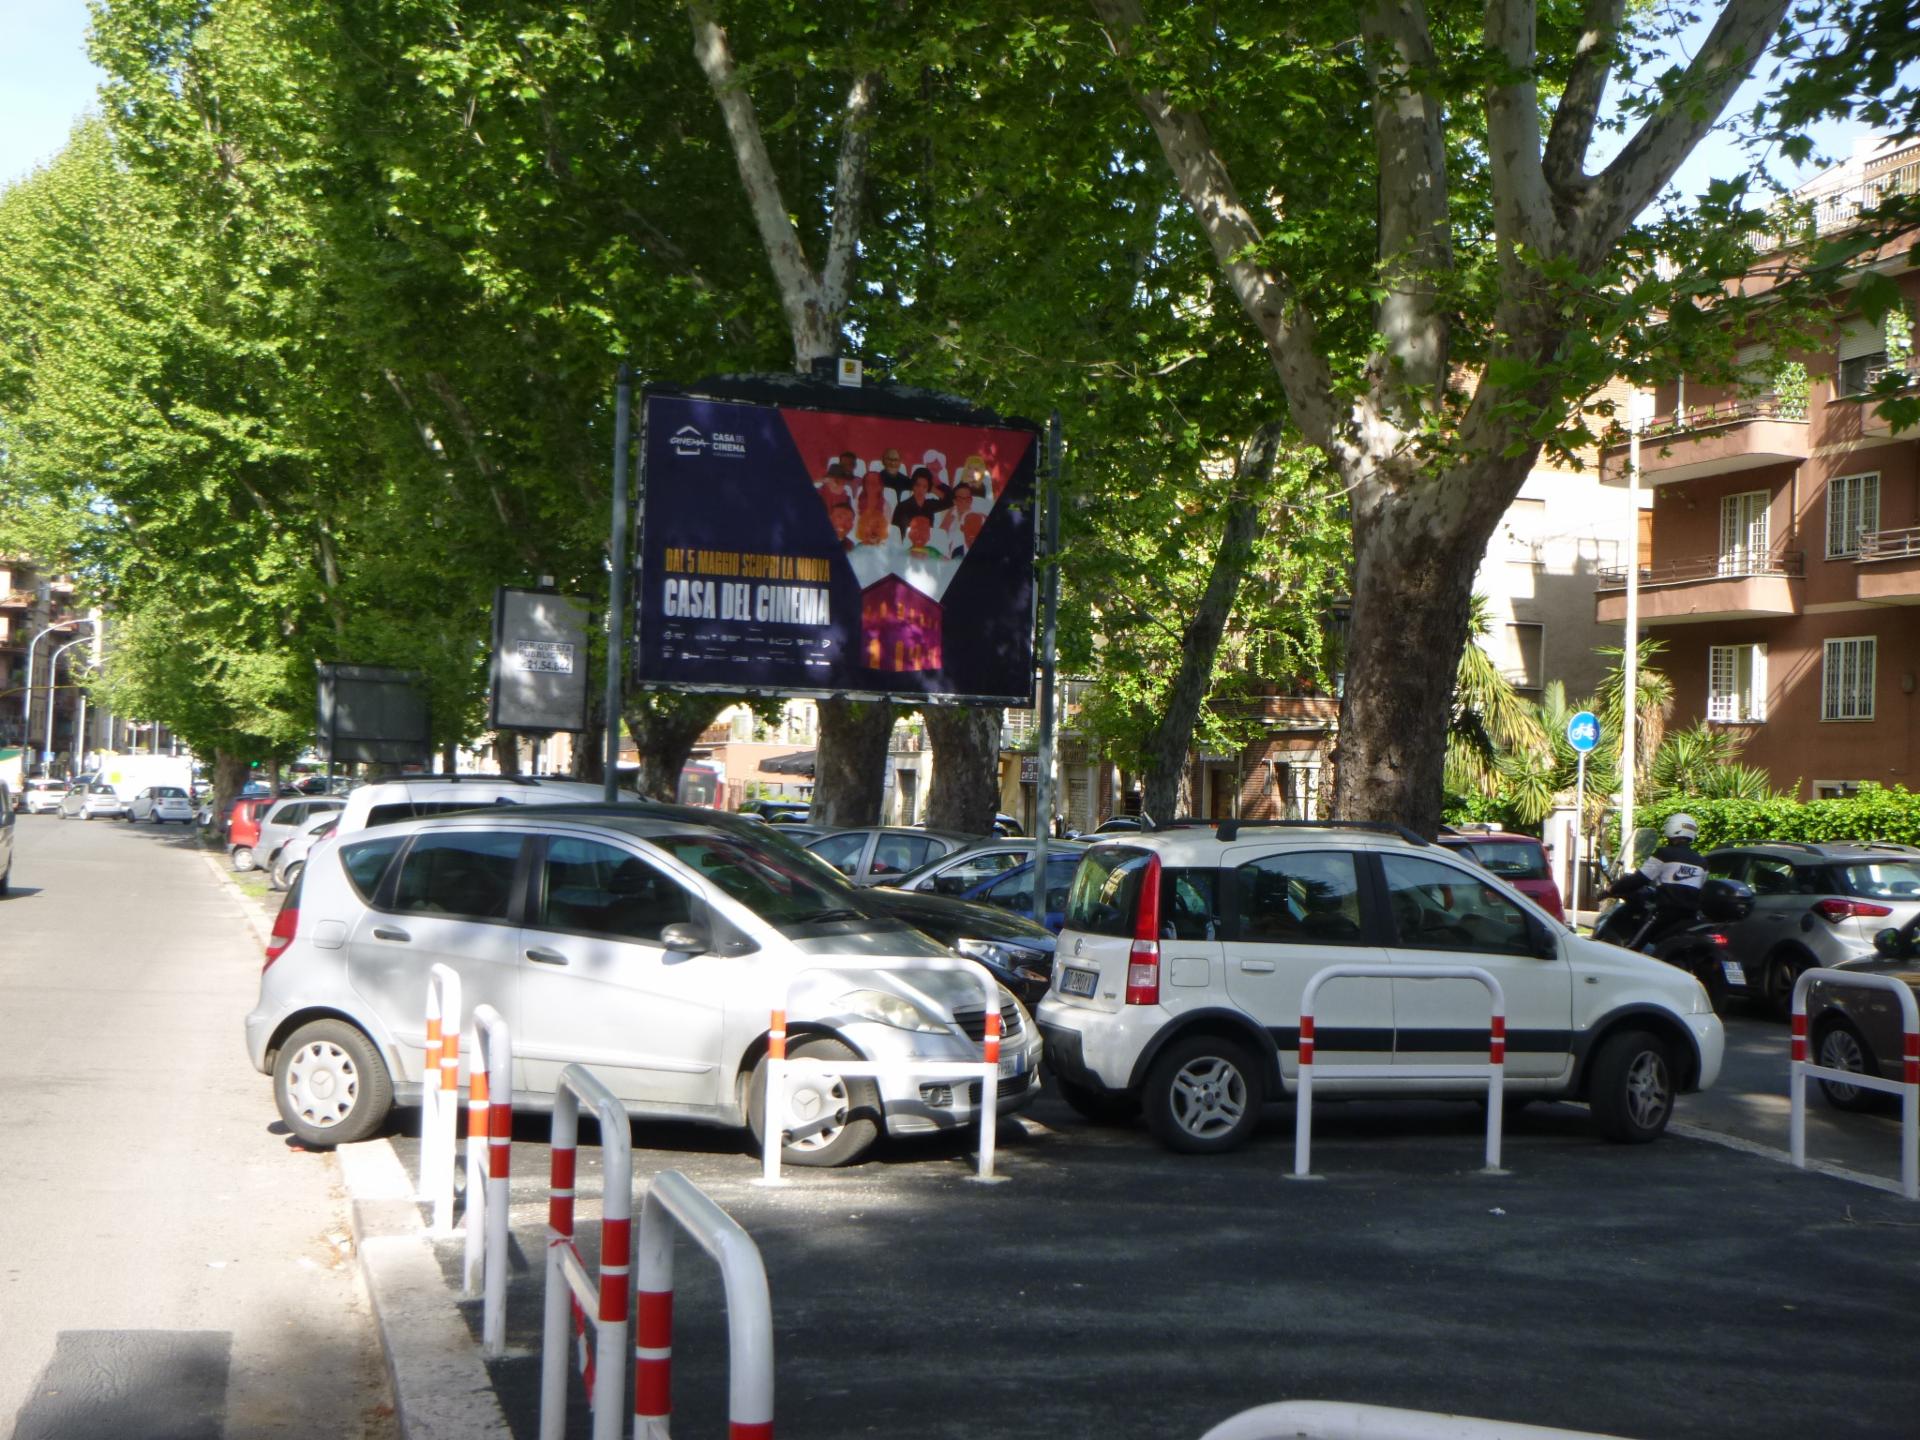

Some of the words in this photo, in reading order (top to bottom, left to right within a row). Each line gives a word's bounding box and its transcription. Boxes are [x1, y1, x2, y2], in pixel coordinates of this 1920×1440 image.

[713, 432, 735, 442] CASA
[713, 443, 746, 453] CINEMA
[665, 548, 684, 573] DAL
[687, 549, 695, 573] 5
[698, 550, 740, 577] MAGGIO
[742, 553, 780, 579] SCOPRI
[783, 556, 795, 580] LA
[797, 557, 831, 582] NUOVA
[664, 578, 717, 620] CASA
[720, 582, 752, 622] DEL
[756, 585, 831, 626] CINEMA
[1678, 864, 1698, 876] NIKE
